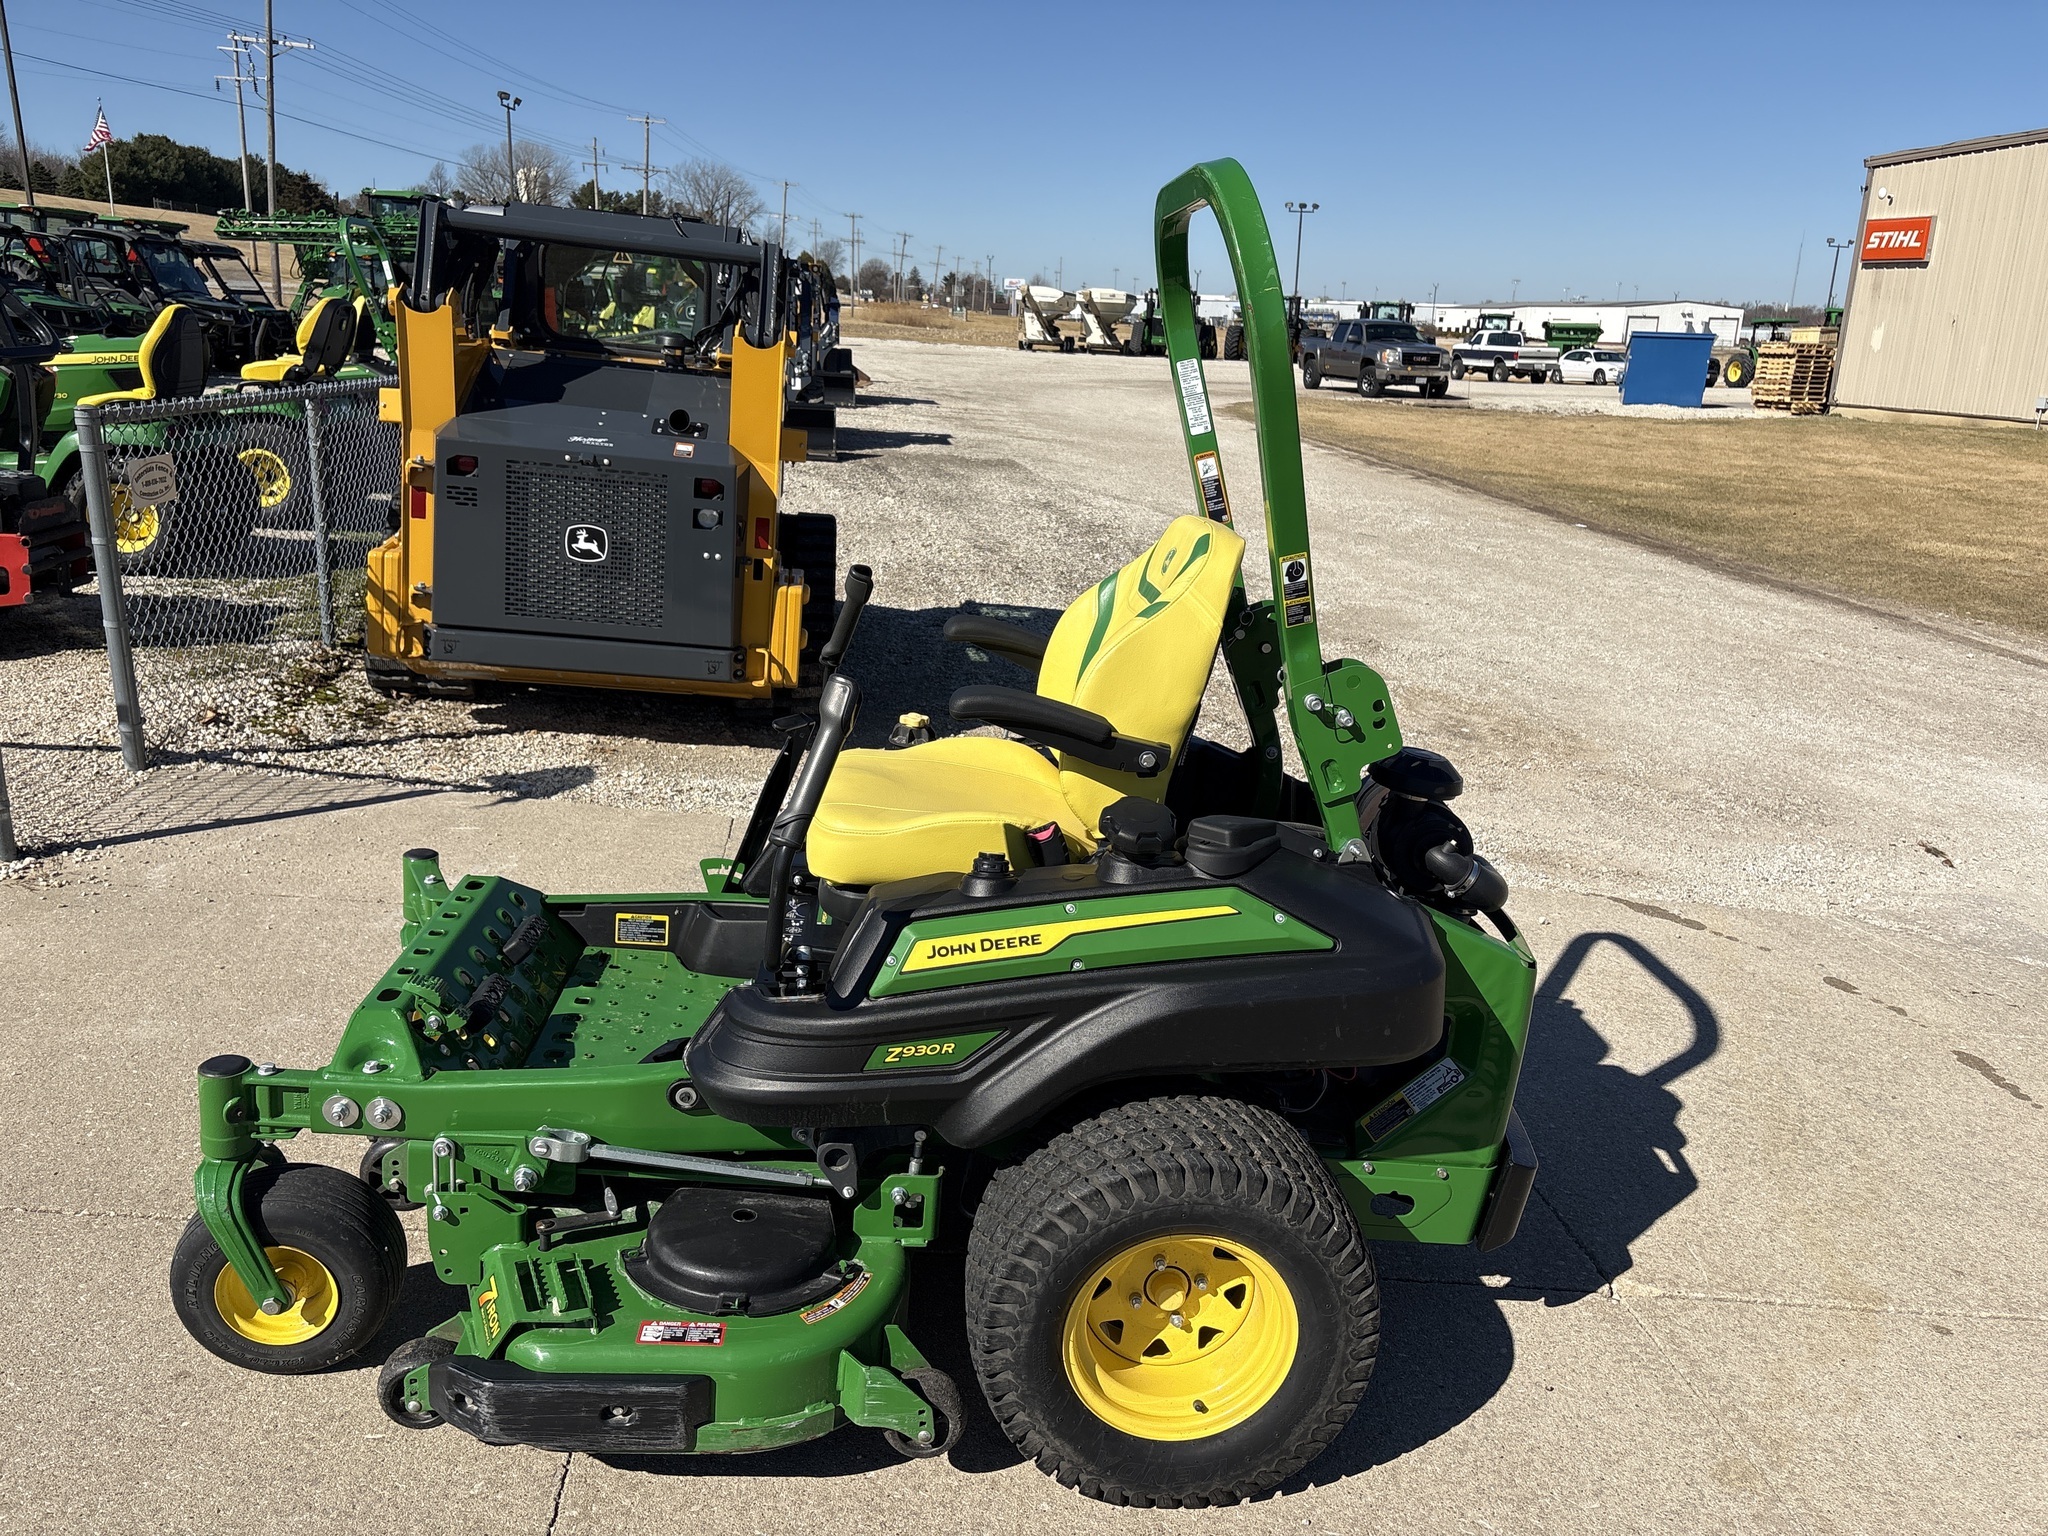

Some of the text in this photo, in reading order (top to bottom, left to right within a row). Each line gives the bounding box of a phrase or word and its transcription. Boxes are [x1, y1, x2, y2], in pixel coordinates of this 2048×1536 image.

[1865, 229, 1922, 249] STIHL
[91, 355, 118, 364] JOHN
[927, 934, 1042, 959] JOHN DEERE
[331, 1273, 366, 1349] CARLISLE
[486, 1299, 501, 1339] IRON
